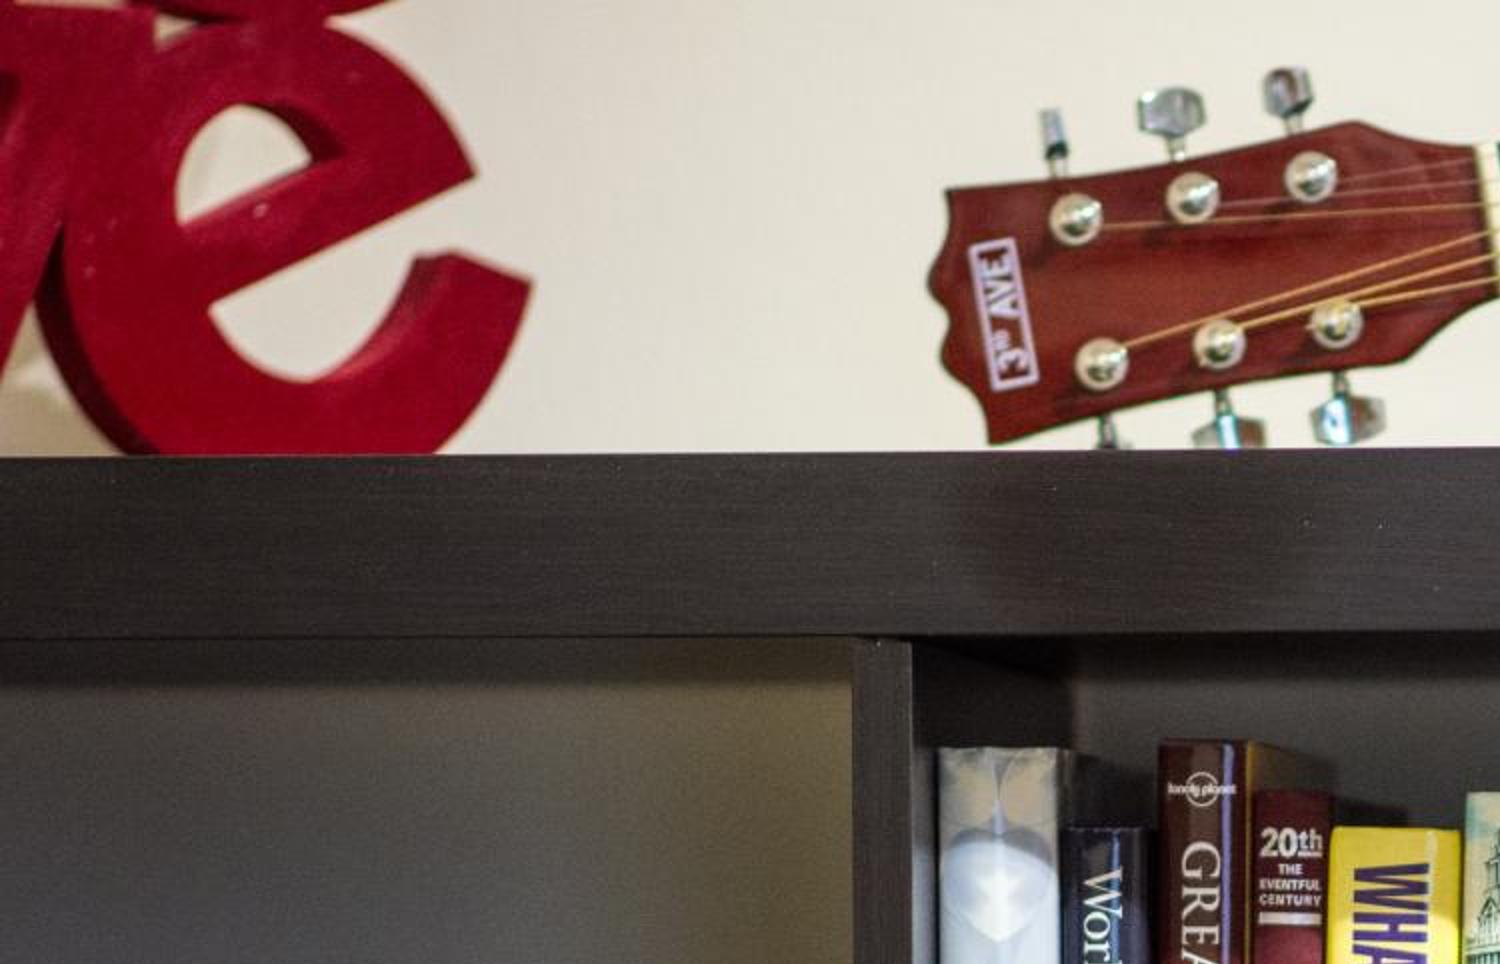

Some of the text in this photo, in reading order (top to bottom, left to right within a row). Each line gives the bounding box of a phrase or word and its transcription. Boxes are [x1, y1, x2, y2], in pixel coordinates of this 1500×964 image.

[1167, 782, 1236, 797] lonely planet
[1260, 826, 1323, 858] 20th
[1277, 863, 1303, 875] THE
[1259, 879, 1321, 891] EVENTFUL
[1259, 894, 1322, 907] CENTURY
